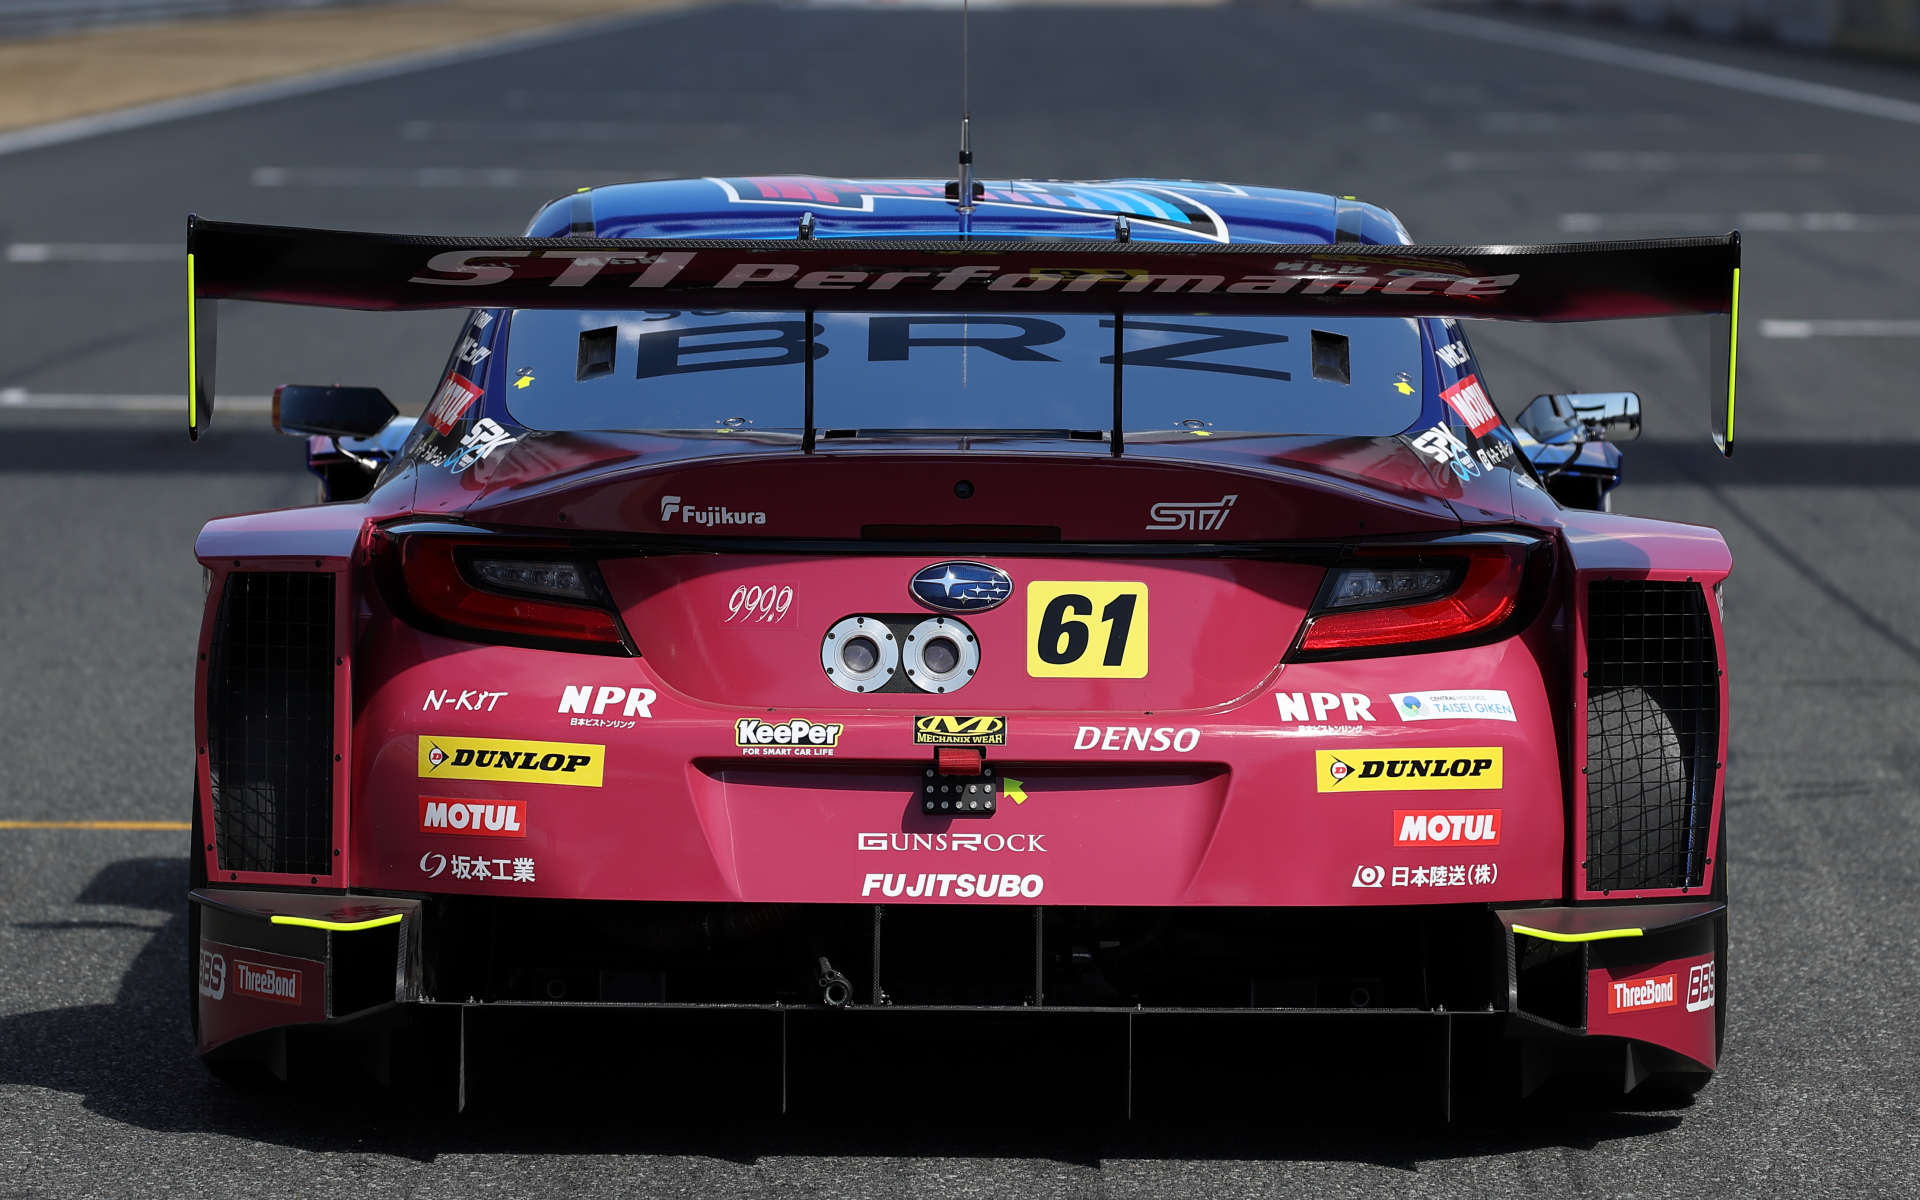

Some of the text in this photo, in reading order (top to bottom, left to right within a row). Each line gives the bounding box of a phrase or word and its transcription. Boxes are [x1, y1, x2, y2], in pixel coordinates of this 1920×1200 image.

[408, 250, 1520, 296] STI Performance
[636, 315, 1292, 382] BRZ
[1450, 381, 1496, 430] MOTUL
[460, 417, 518, 460] SPK
[1411, 420, 1468, 464] SPK
[682, 505, 767, 527] Fujikura
[723, 584, 794, 624] 999.9
[1037, 593, 1138, 667] 61
[422, 689, 509, 712] N-KIT
[557, 685, 657, 718] NPR
[1275, 692, 1377, 722] NPR
[1433, 703, 1513, 715] TAISEI GIKEN
[569, 717, 636, 729] 日本ピストンリング
[737, 719, 841, 745] KeePer
[742, 747, 834, 756] FOR SMART CAR LIFE
[917, 731, 1003, 744] MECHANIX WEAR
[1073, 725, 1201, 753] DENSO
[451, 748, 591, 773] DUNLOP
[1358, 758, 1493, 779] DUNLOP
[423, 802, 520, 832] MOTUL
[1399, 814, 1496, 842] MOTUL
[451, 854, 536, 883] 坂本工業
[1391, 863, 1499, 888] 日本陸送(株)
[861, 873, 1044, 898] FUJITSUBO
[238, 964, 296, 998] ThreeBond
[1613, 976, 1673, 1009] ThreeBond
